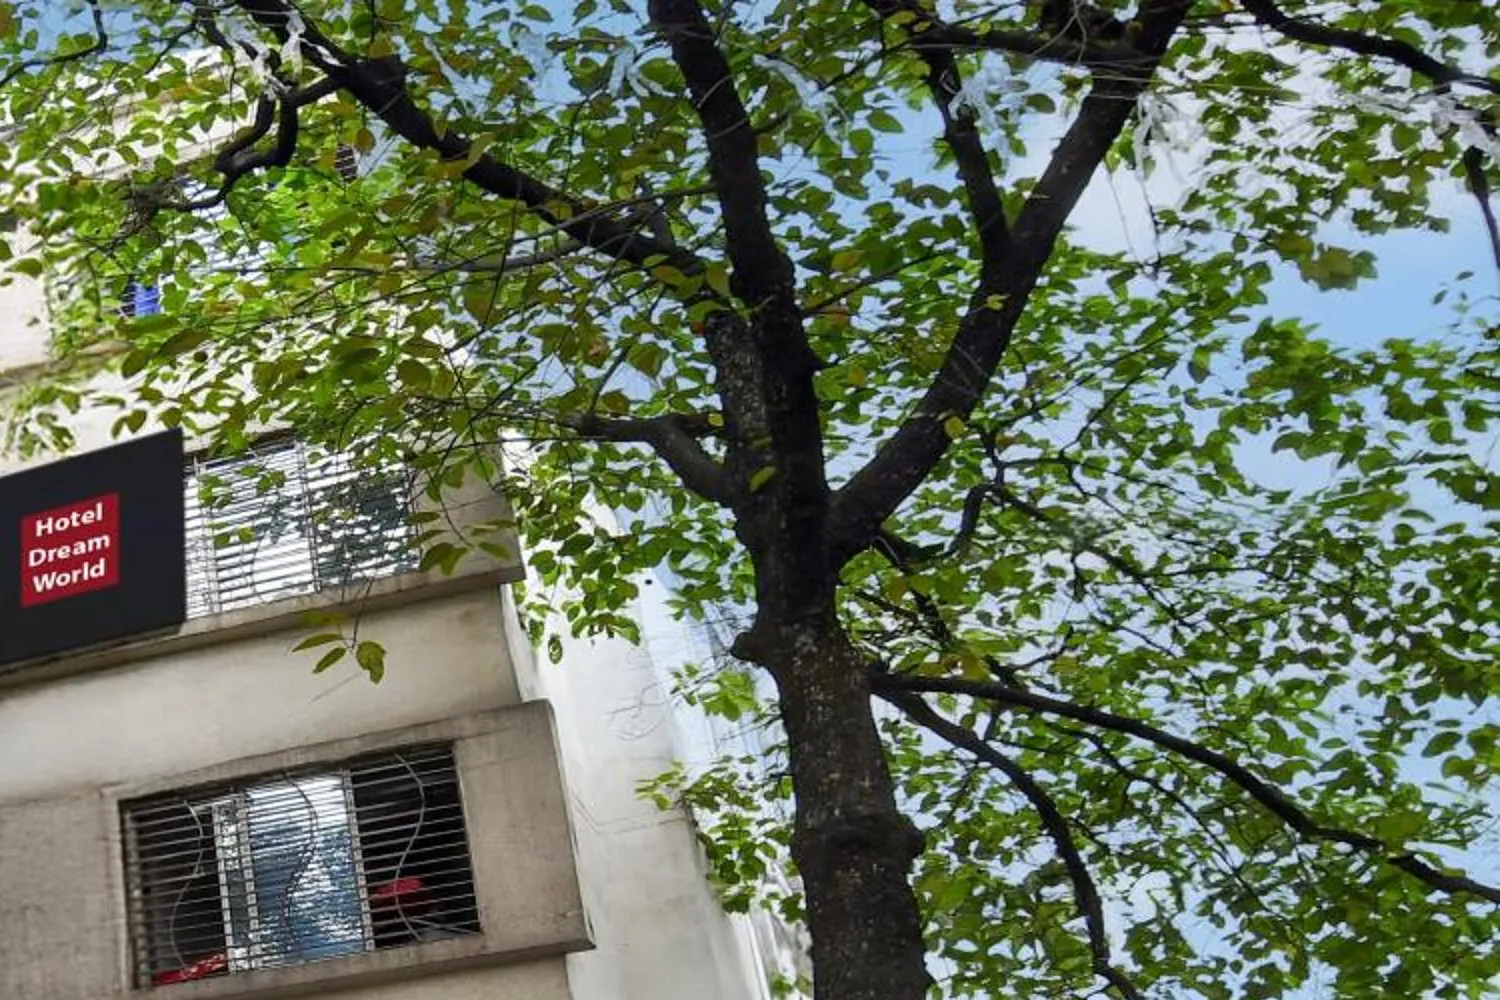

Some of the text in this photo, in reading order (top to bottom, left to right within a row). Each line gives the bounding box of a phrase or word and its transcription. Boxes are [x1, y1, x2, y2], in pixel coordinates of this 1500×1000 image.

[35, 502, 104, 538] Hotel
[28, 532, 111, 568] Dream
[32, 558, 106, 594] World
